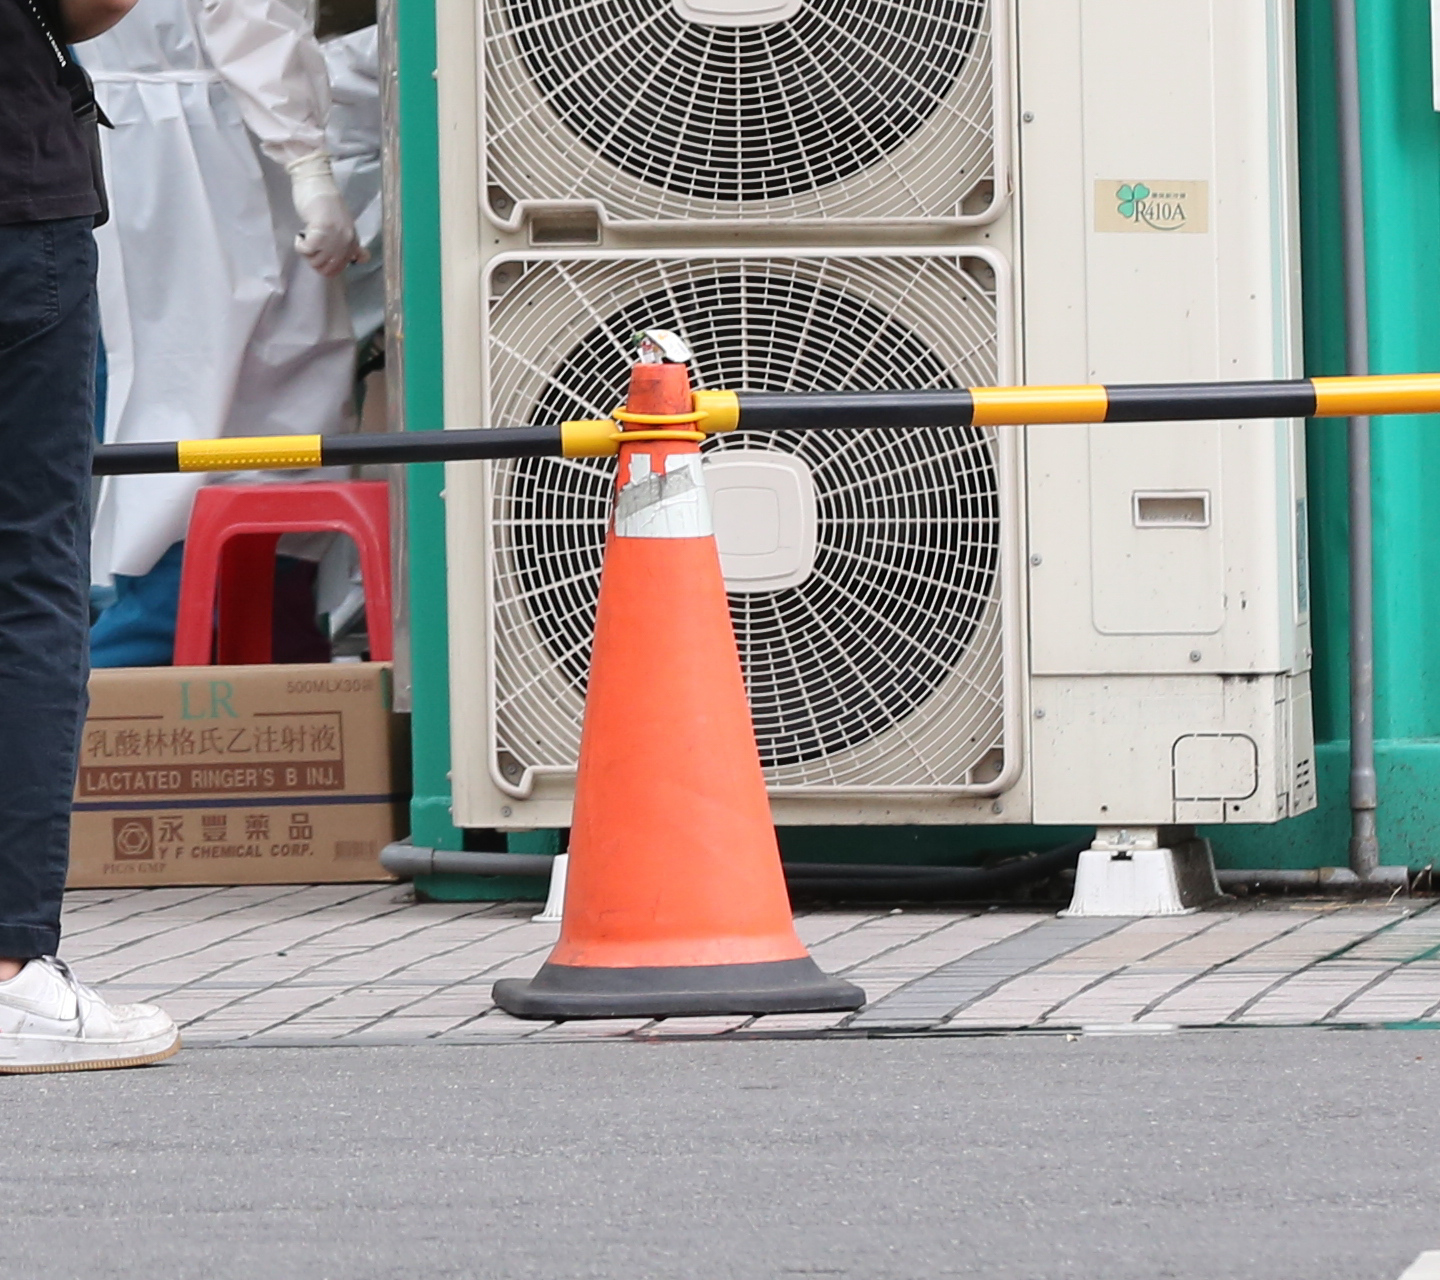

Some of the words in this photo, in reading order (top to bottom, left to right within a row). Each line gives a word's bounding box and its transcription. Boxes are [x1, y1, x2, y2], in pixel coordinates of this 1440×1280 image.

[1134, 200, 1187, 226] R410A
[179, 679, 239, 721] LR
[87, 724, 337, 759] 乳酸林格氏乙注射液
[87, 771, 182, 791] LACTATED
[190, 768, 275, 790] RINGER'S
[286, 767, 298, 786] B
[306, 766, 339, 786] INJ.
[157, 847, 168, 860] Y
[175, 847, 185, 860] F
[190, 844, 263, 859] CHEMICAL
[270, 842, 314, 858] CORP.
